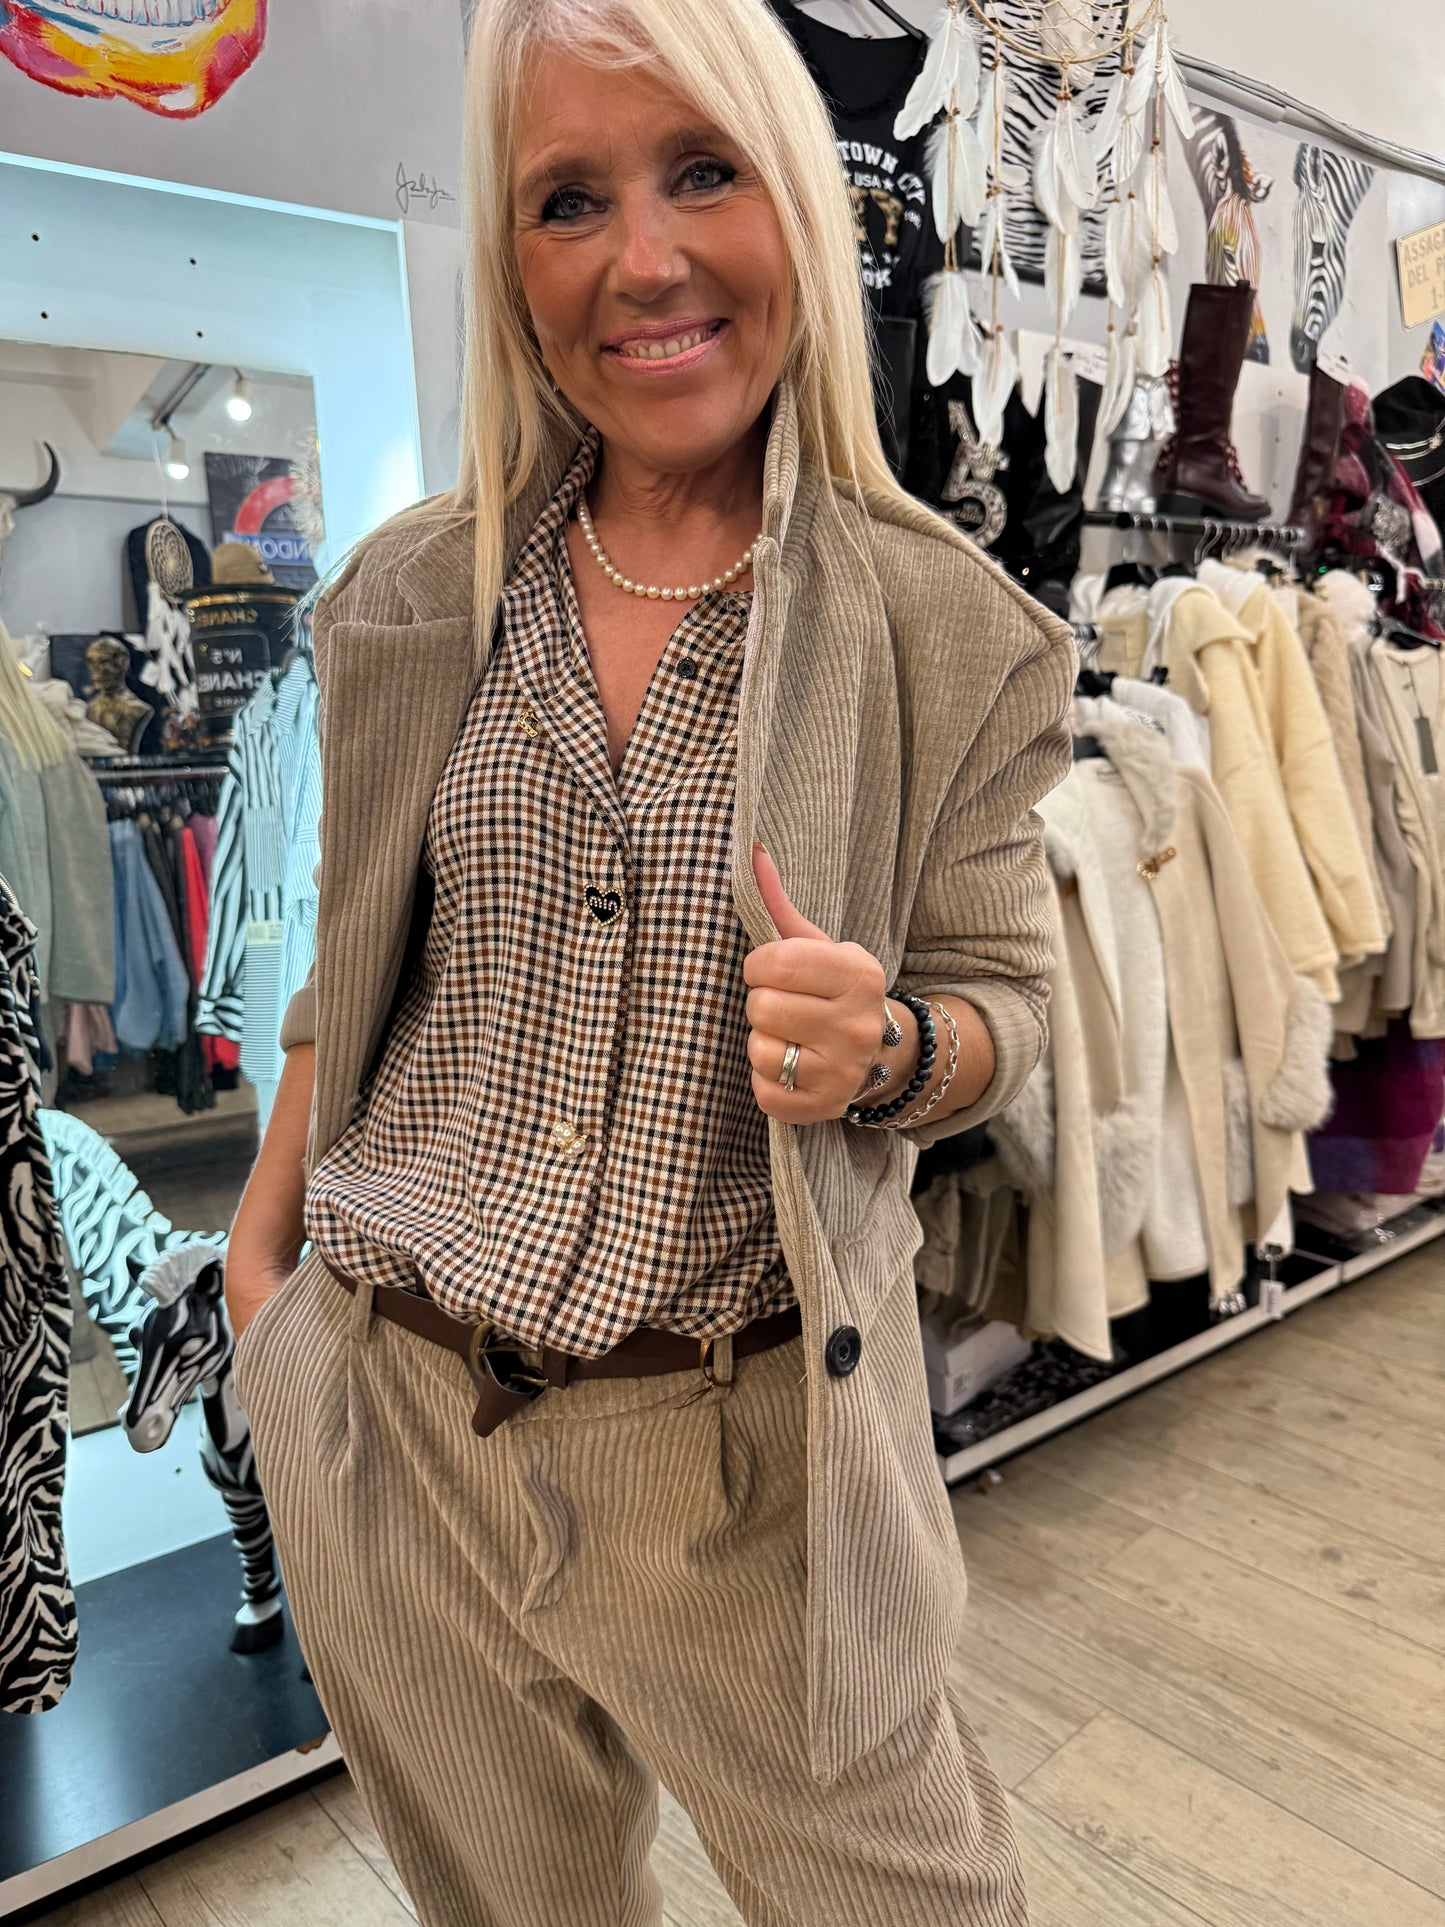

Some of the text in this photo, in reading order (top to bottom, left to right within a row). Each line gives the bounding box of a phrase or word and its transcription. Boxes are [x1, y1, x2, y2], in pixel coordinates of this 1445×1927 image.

[854, 171, 882, 188] USA
[1403, 228, 1445, 265] ASSAG
[1407, 263, 1430, 289] DEL
